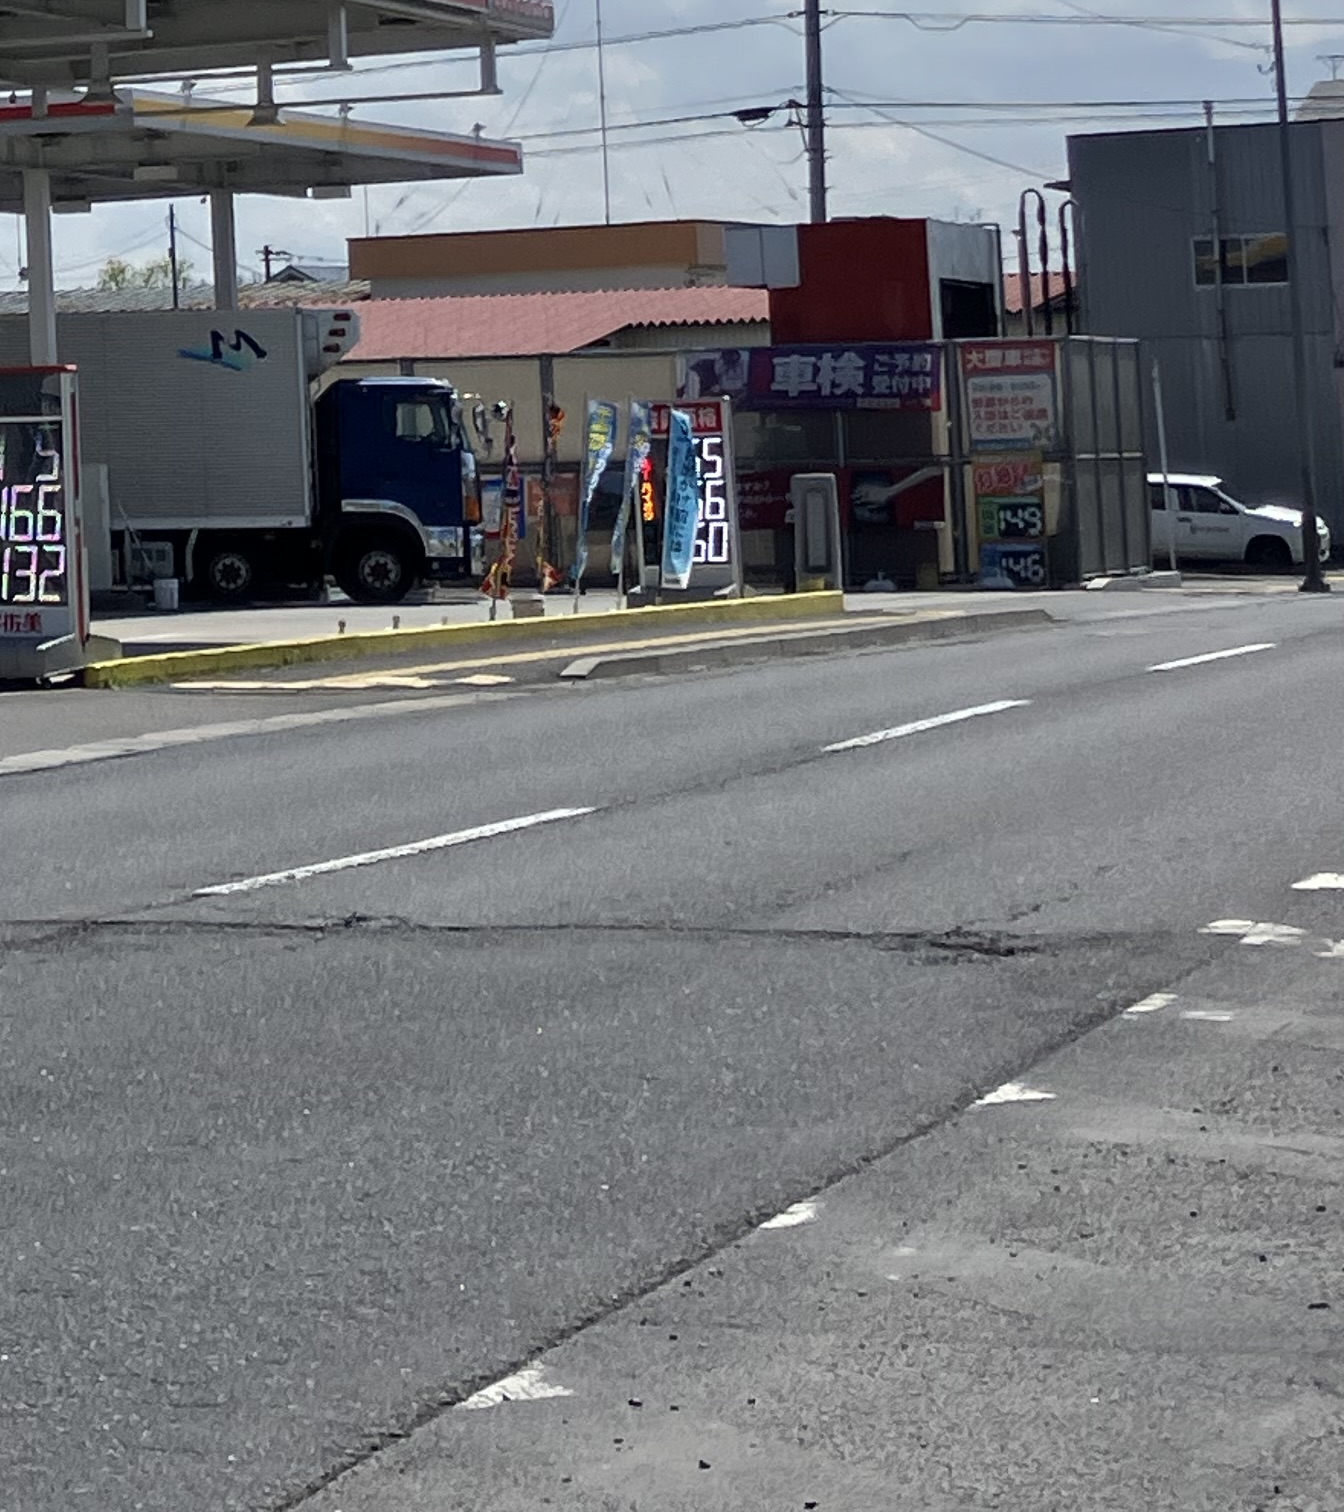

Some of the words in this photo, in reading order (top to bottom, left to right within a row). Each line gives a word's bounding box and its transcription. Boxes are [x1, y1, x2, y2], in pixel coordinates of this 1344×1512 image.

[770, 351, 866, 397] 車検
[872, 374, 932, 395] 受付中
[874, 353, 932, 373] ご予約
[0, 484, 62, 542] 166
[1, 545, 66, 603] 132
